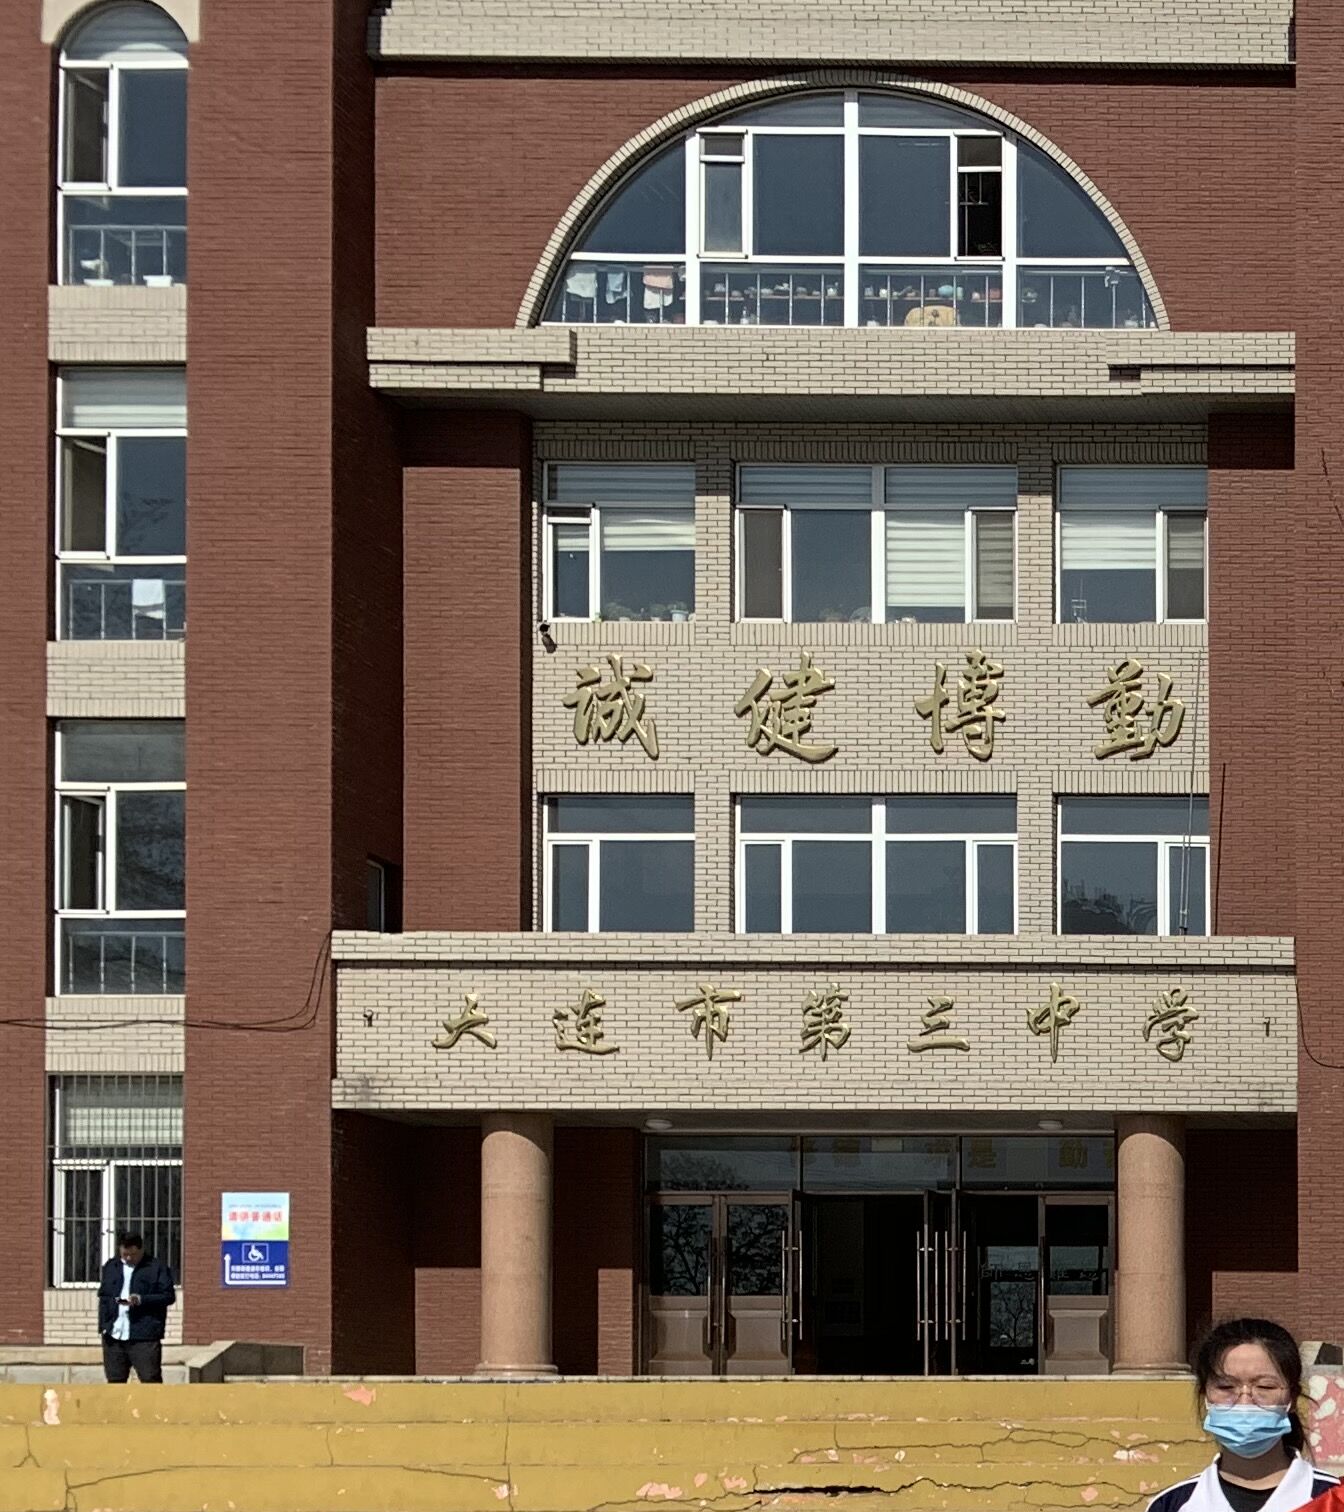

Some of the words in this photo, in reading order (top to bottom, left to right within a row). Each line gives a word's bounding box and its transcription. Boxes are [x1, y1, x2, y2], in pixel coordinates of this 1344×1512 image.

[431, 982, 1201, 1062] 大连市第三中学
